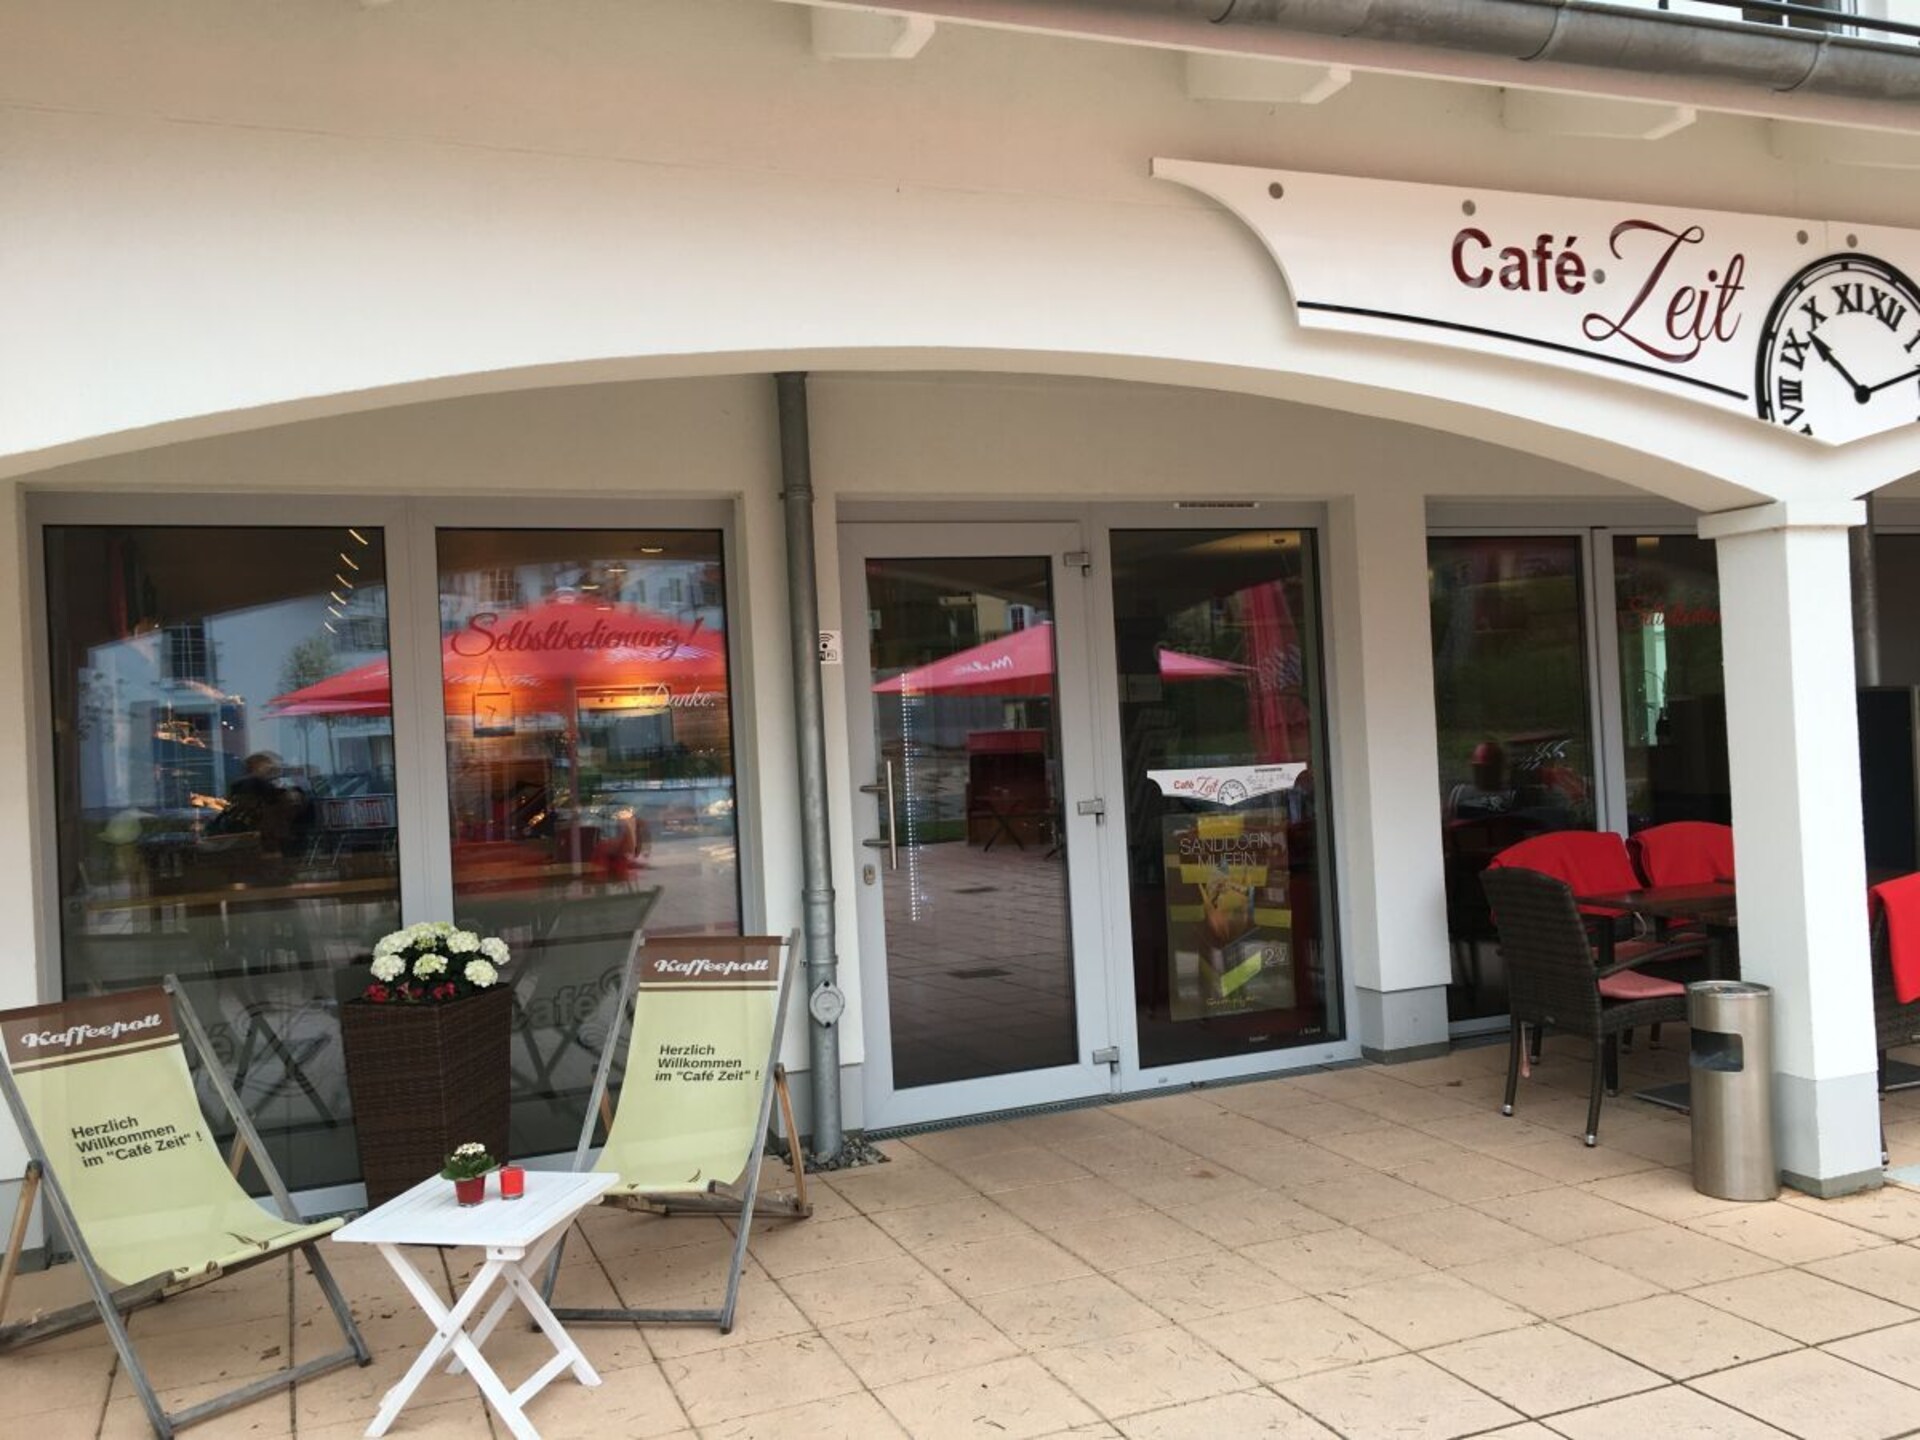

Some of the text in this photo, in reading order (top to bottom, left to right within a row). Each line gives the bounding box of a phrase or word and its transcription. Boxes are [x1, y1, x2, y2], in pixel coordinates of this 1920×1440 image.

[1451, 218, 1746, 363] Café Zeit
[1799, 295, 1829, 332] X
[1831, 283, 1864, 316] XI
[654, 958, 769, 977] Kaffeepott
[21, 1013, 163, 1048] Kaffeepott
[659, 1044, 715, 1056] Herzlich
[658, 1057, 742, 1068] Willkommen
[655, 1070, 672, 1081] im
[71, 1115, 139, 1139] Herzlich
[75, 1124, 176, 1154] Willkommen
[82, 1153, 104, 1168] im
